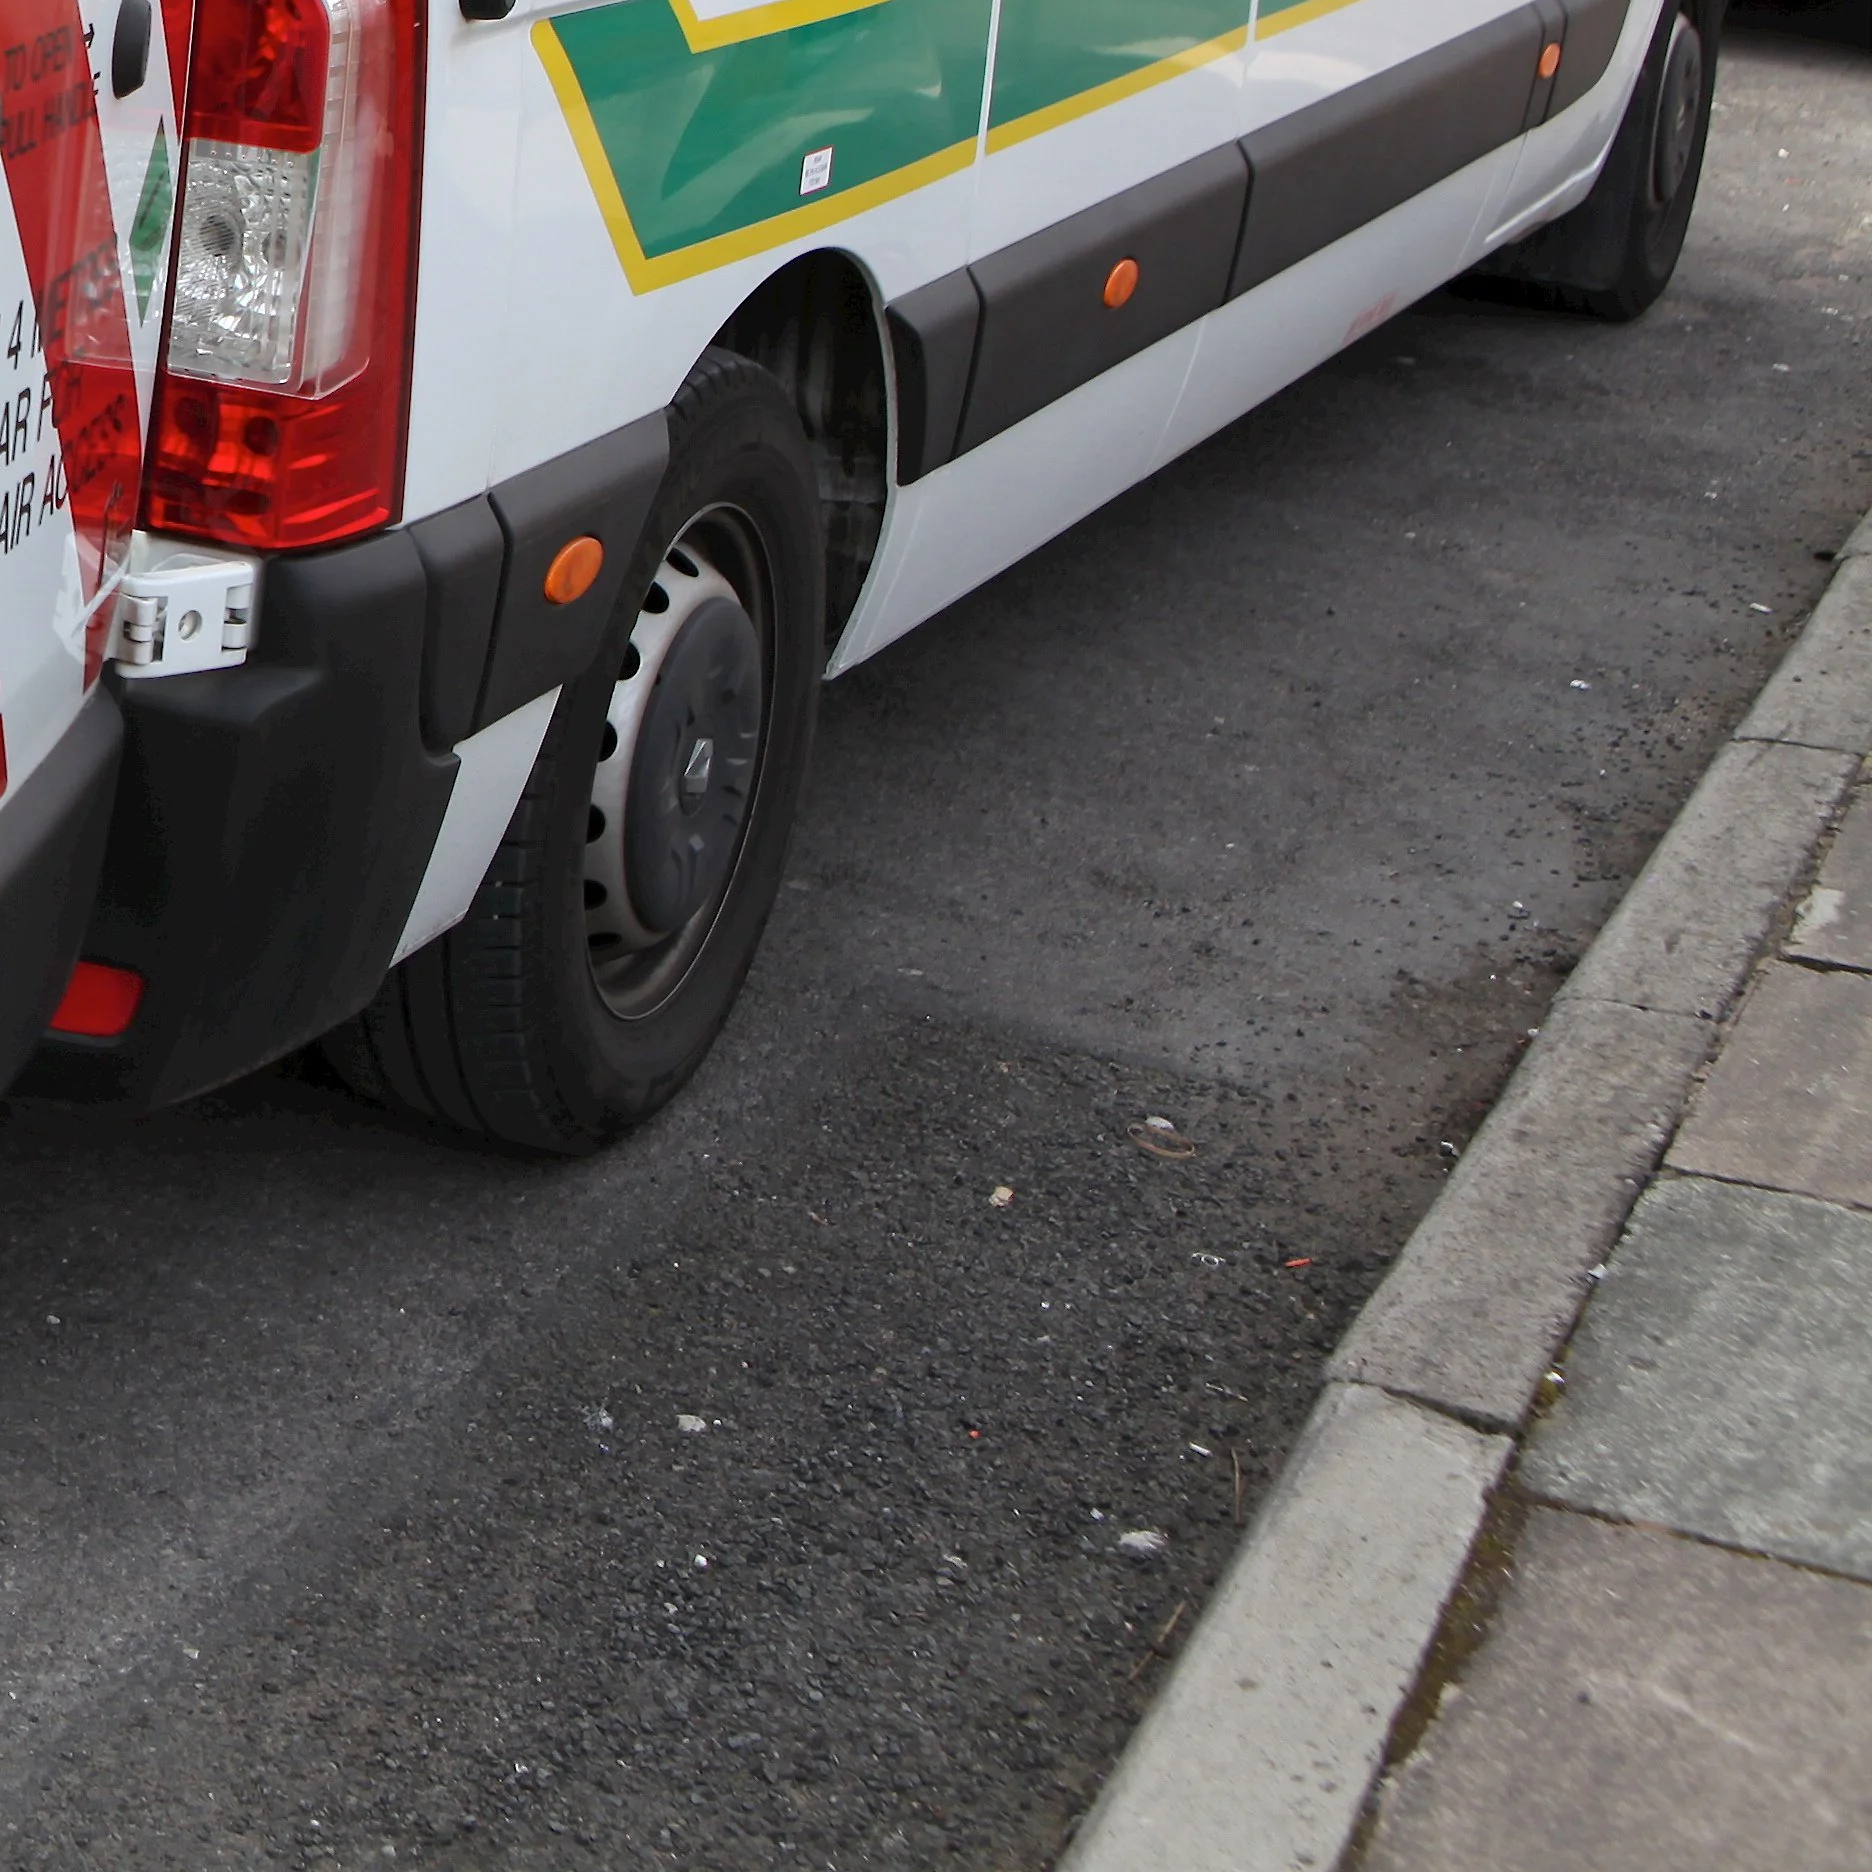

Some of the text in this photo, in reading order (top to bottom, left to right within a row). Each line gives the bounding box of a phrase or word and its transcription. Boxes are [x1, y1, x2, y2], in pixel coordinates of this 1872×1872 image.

[4, 21, 76, 94] TO OPEN
[44, 71, 101, 142] HANDLE
[6, 299, 24, 371] 4
[37, 349, 83, 443] FOR
